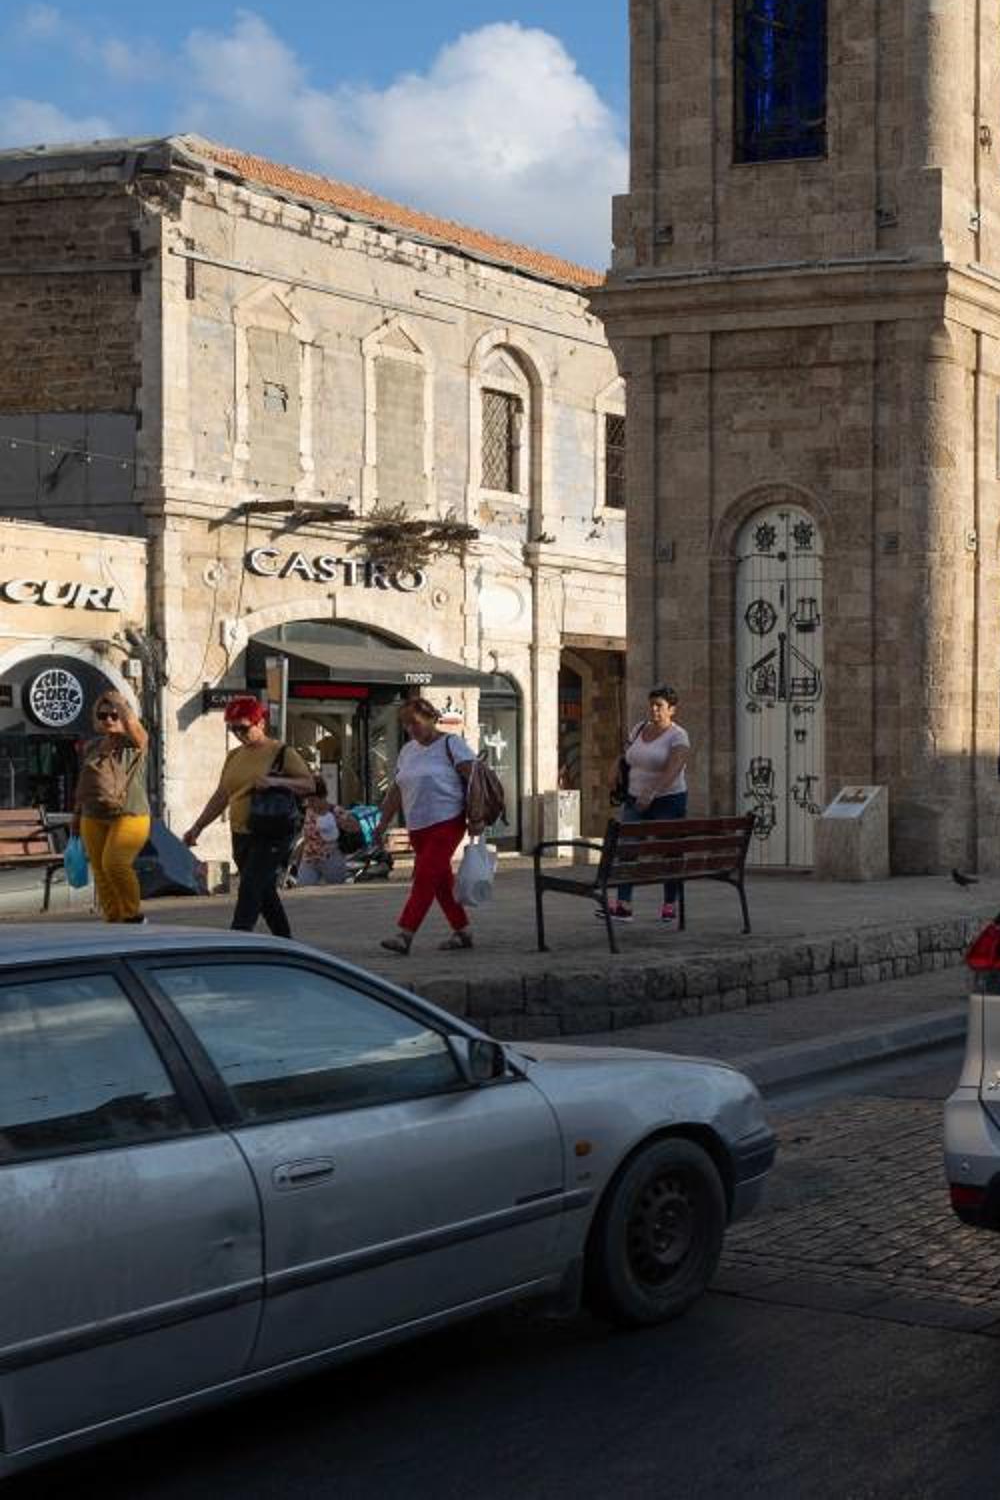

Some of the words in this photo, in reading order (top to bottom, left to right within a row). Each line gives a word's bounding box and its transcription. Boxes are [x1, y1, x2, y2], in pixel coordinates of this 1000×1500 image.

[243, 548, 426, 593] CASTRO
[0, 579, 121, 612] CURL
[36, 671, 68, 689] RIP
[33, 687, 81, 705] CURL
